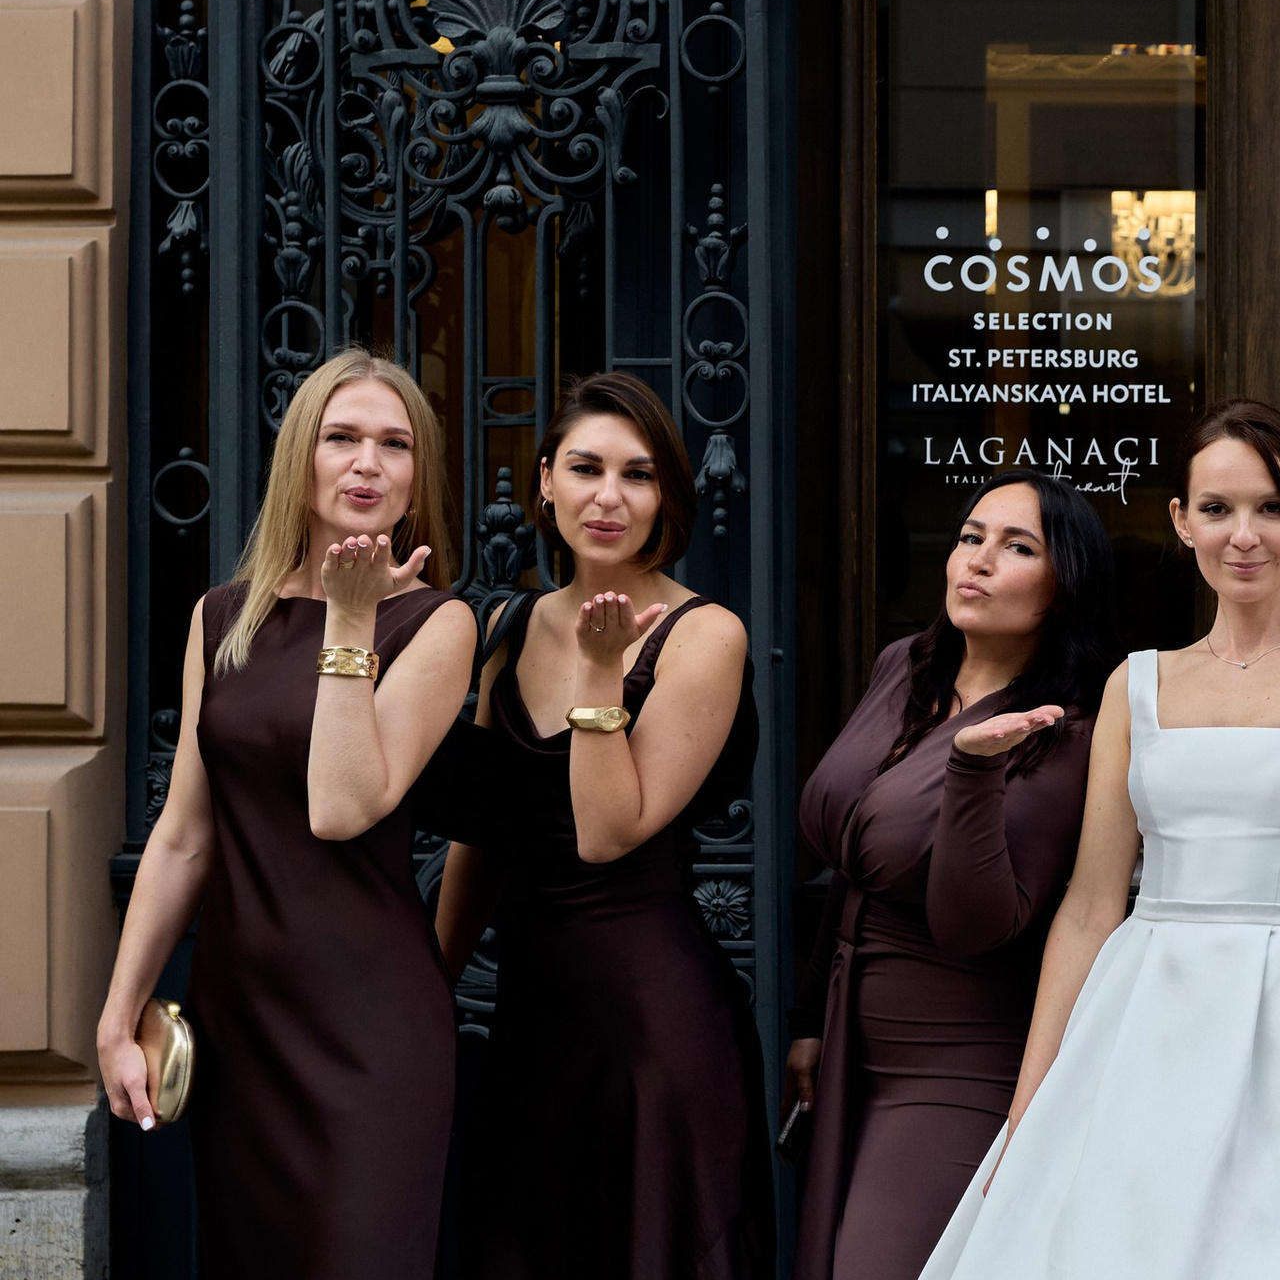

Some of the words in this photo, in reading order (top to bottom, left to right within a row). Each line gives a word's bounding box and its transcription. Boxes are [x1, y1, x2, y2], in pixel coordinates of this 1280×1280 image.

[923, 254, 1162, 293] COSMOS
[972, 312, 1113, 331] SELECTION
[948, 348, 982, 368] ST.
[987, 348, 1139, 369] PETERSBURG
[911, 383, 1087, 404] ITALYANSKAYA
[1092, 383, 1171, 404] HOTEL
[923, 437, 1160, 466] LAGANACI
